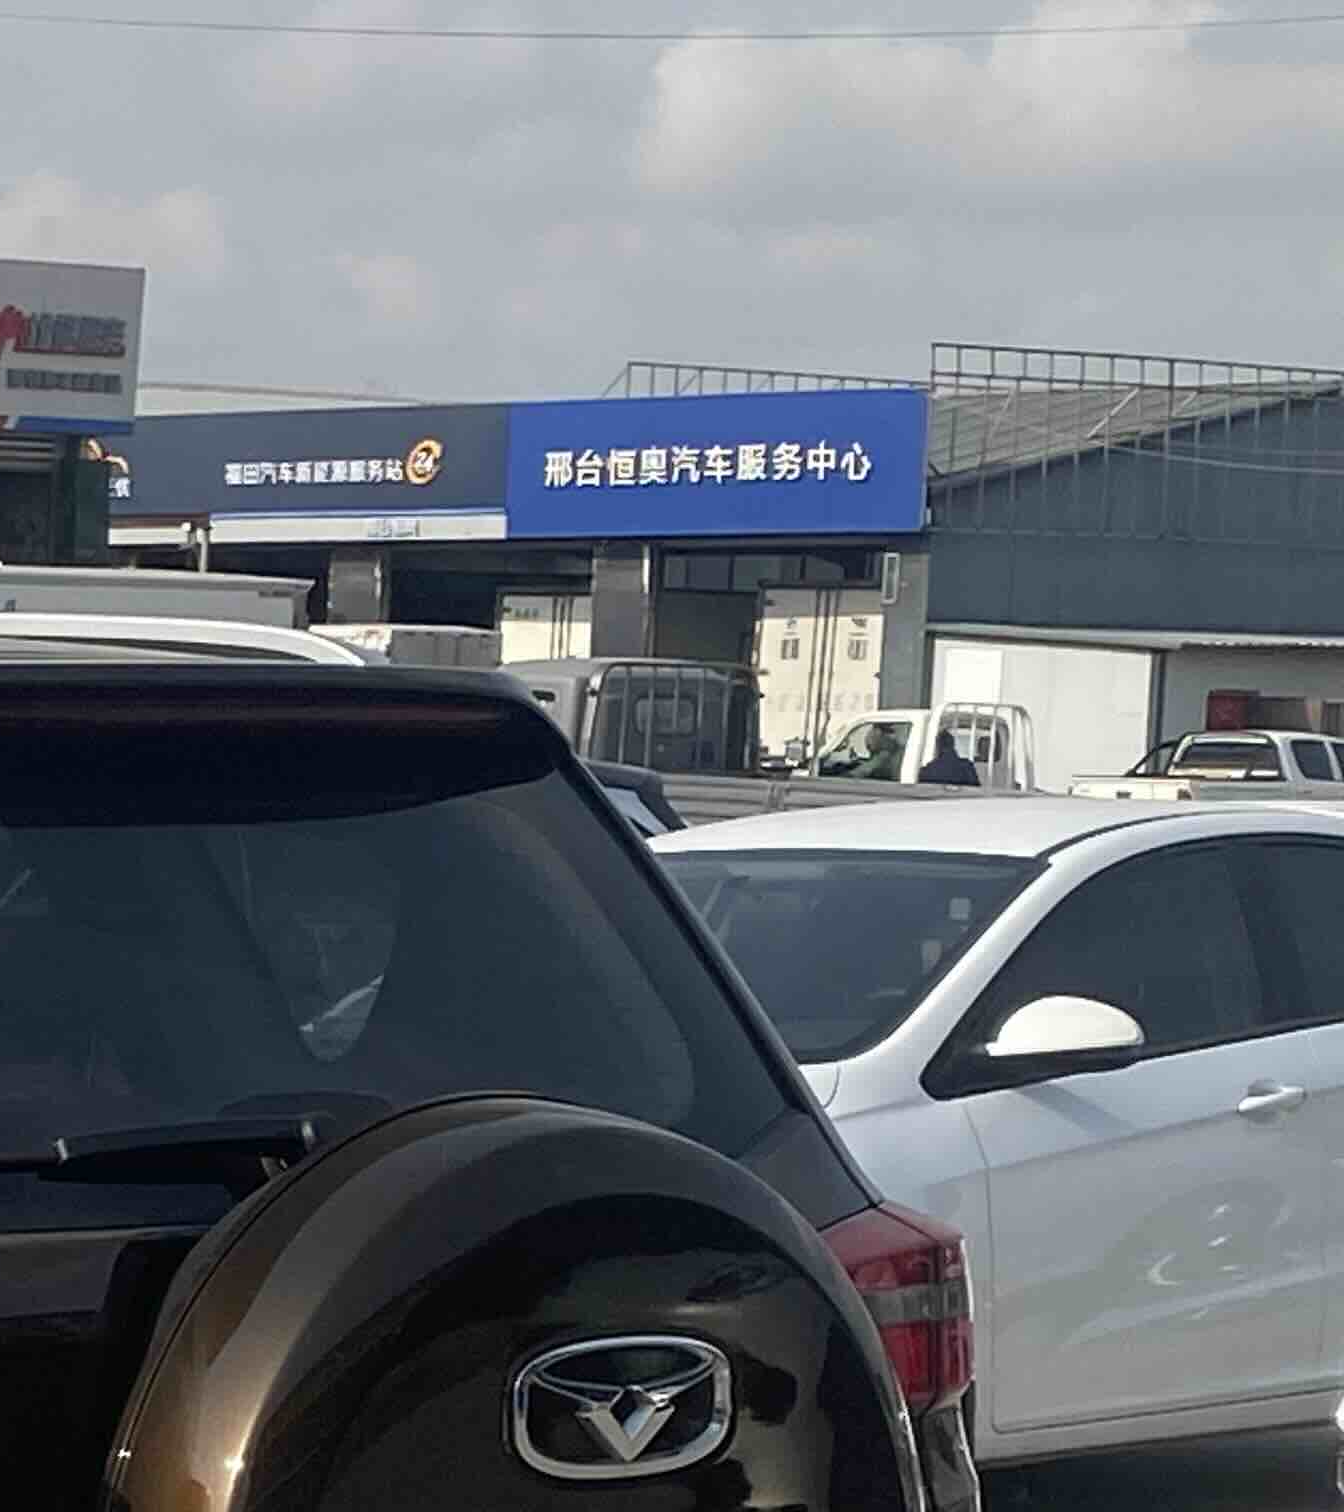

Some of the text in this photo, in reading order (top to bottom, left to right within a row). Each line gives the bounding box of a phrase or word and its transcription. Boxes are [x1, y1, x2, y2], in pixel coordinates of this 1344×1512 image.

[543, 441, 872, 488] 邢台恒奥汽车服务中心
